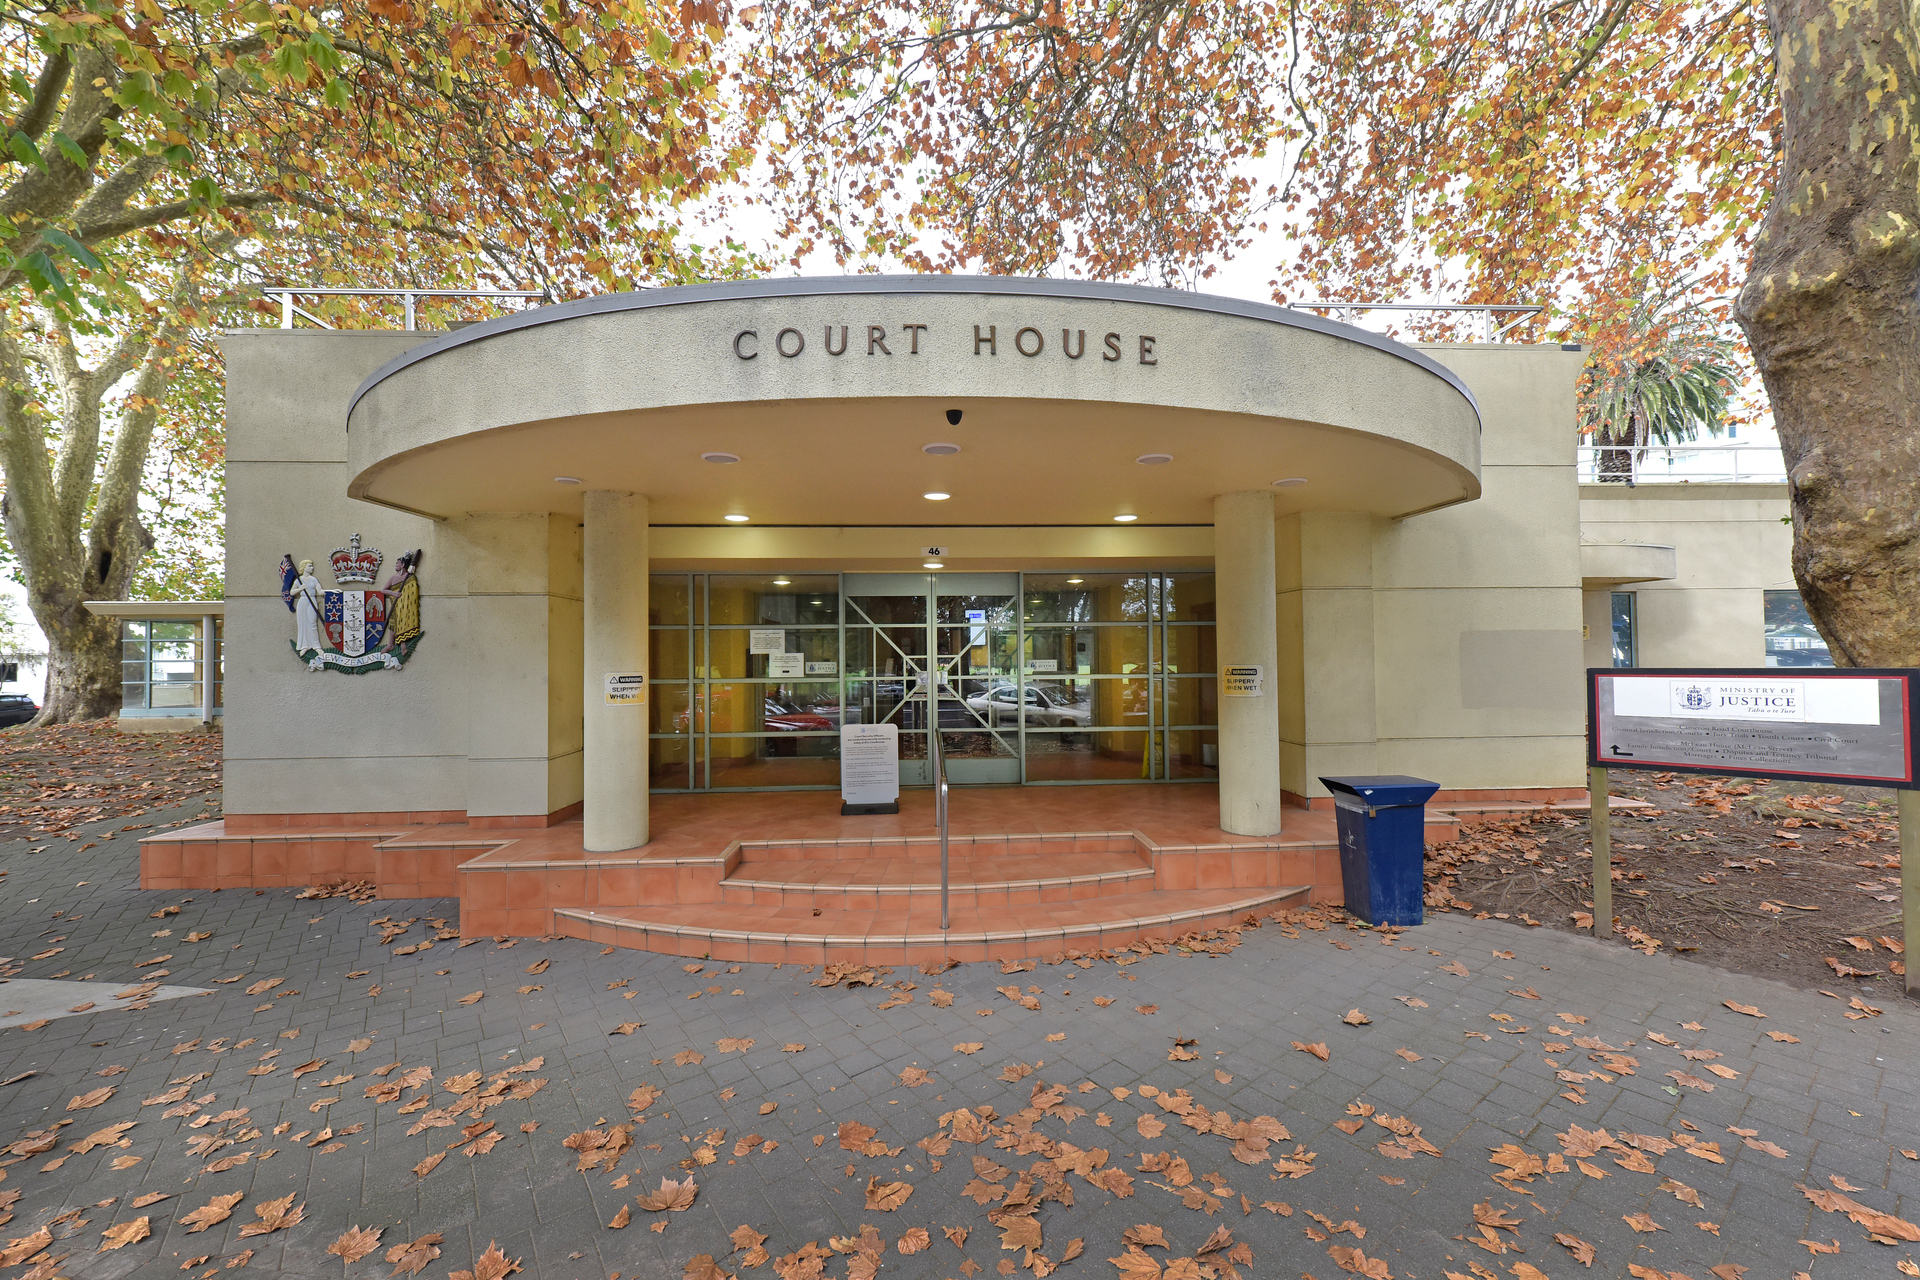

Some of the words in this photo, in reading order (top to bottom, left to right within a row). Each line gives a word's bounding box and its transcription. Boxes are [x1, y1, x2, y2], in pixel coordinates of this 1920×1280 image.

[732, 323, 928, 360] COURT
[974, 324, 1158, 365] HOUSE
[928, 547, 940, 556] 46
[318, 655, 340, 663] NEW
[344, 654, 387, 666] ZEALAND
[1719, 696, 1796, 707] JUSTICE
[1722, 748, 1755, 756] Disputes
